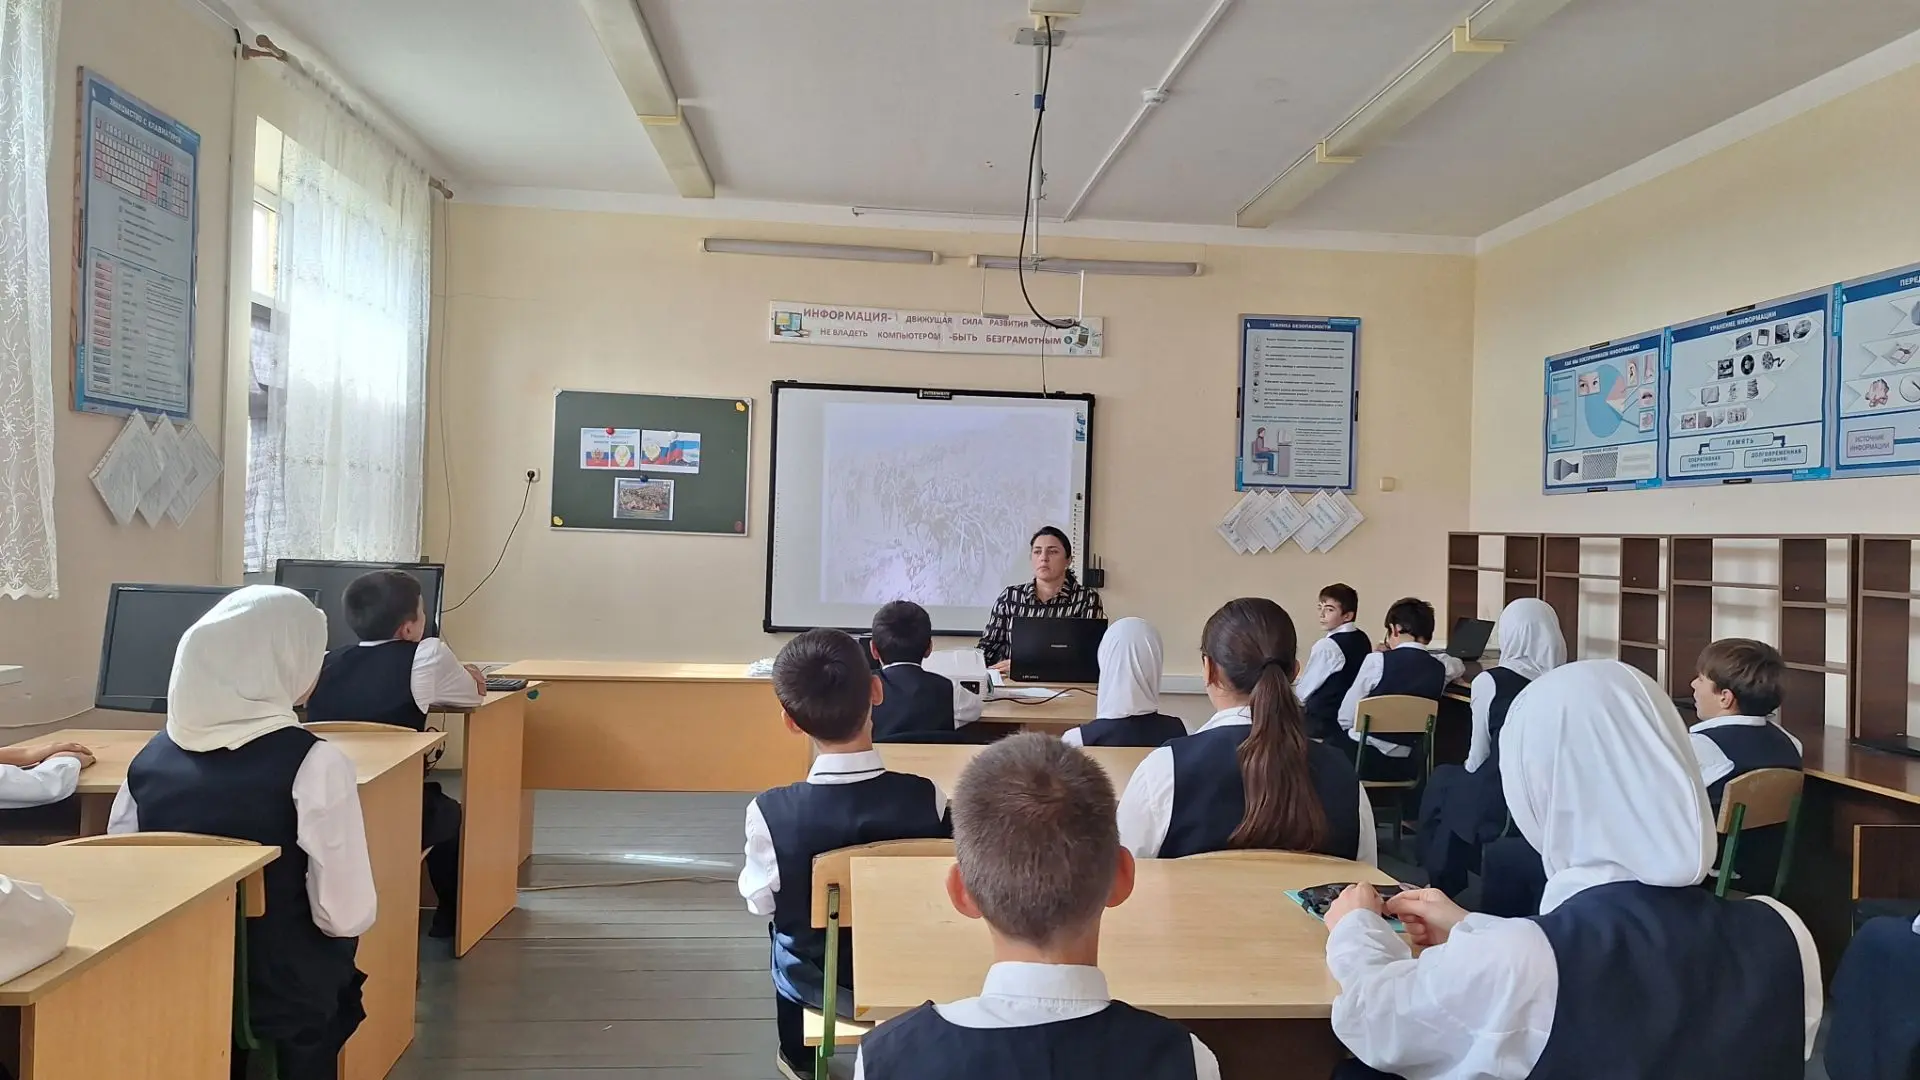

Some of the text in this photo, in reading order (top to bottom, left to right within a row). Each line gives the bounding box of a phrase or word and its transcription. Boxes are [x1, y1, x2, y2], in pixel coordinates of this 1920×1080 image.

[1899, 275, 1920, 287] ПЕРЕ
[905, 315, 953, 325] ДВИЖУЩАЯ
[962, 317, 983, 326] СИЛА
[989, 319, 1029, 328] РАЗВИТИЯ
[820, 327, 831, 336] НЕ
[833, 329, 868, 338] ВЛАДЕТЬ
[985, 334, 1062, 345] БЕЗГРАМОТНЫМ
[1726, 438, 1754, 447] ПАМЯТЬ
